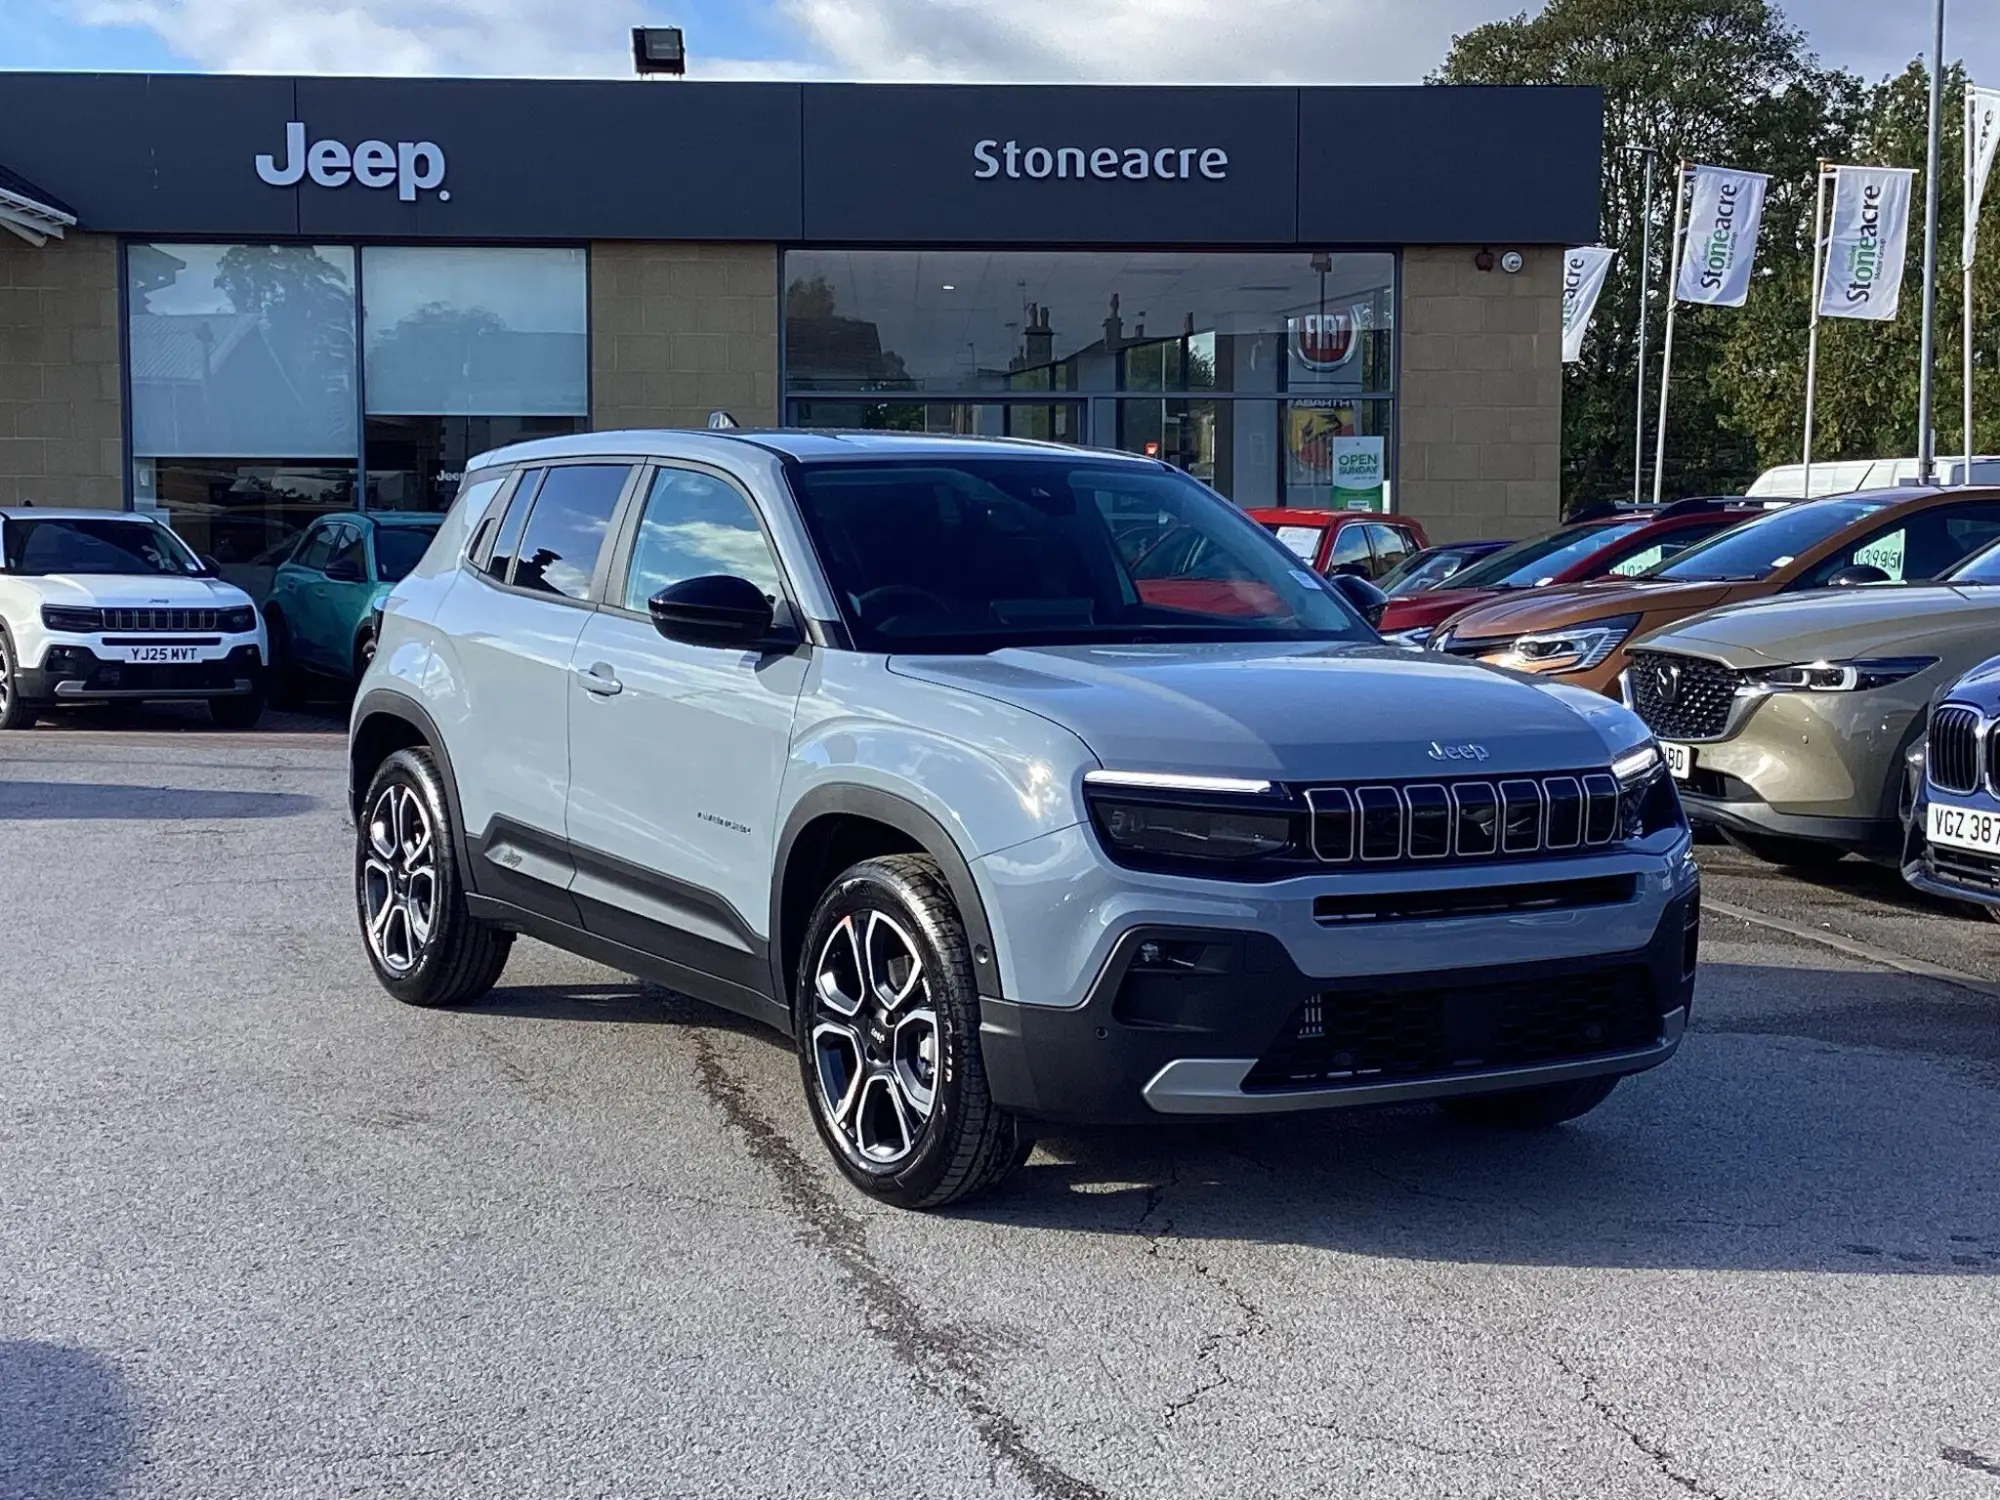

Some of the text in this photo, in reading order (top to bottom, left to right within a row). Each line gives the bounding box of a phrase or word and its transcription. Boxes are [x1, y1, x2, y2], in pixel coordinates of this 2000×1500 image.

[255, 122, 447, 200] Jeep
[974, 139, 1228, 179] Stoneacre
[1700, 183, 1738, 290] Stoneacre
[1846, 184, 1881, 303] Stoneacre
[1305, 314, 1348, 349] FIAT
[1338, 454, 1378, 466] OPEN
[1338, 465, 1379, 476] SUNDAY
[131, 648, 197, 661] YJ25 MVT
[1428, 741, 1490, 762] Jeep
